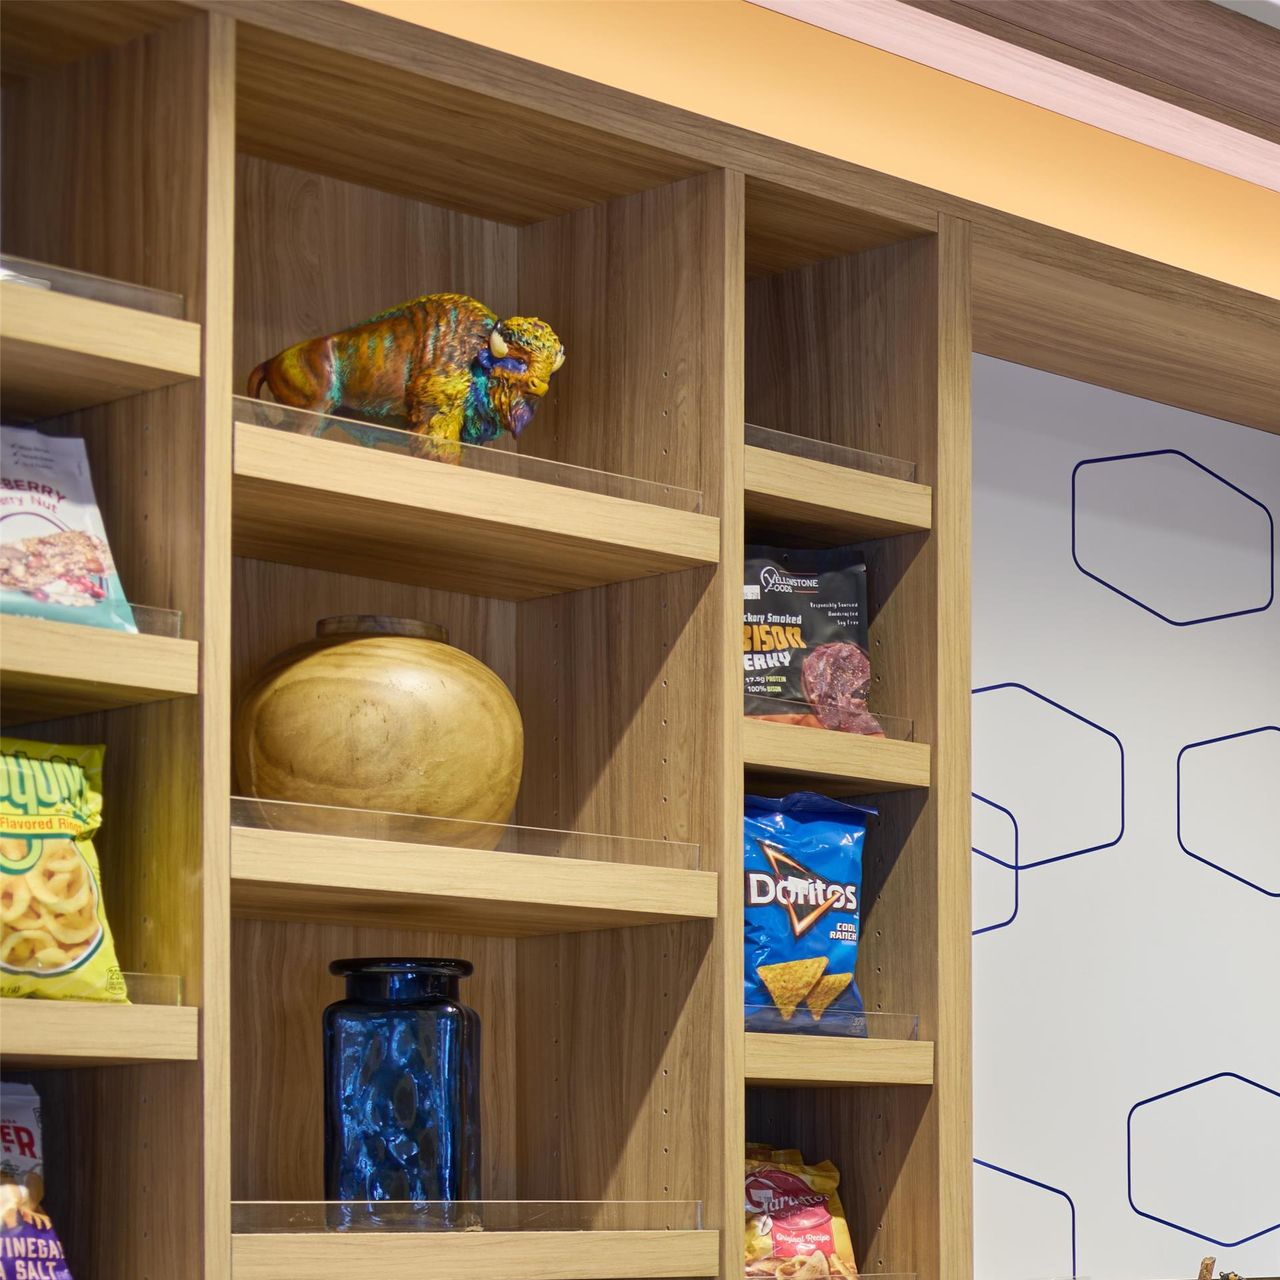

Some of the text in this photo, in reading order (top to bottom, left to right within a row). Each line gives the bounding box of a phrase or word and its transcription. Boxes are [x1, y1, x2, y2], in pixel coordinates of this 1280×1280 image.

[767, 613, 802, 625] Smoked
[743, 624, 807, 651] BISON
[749, 872, 857, 911] Doritos
[836, 923, 857, 932] COOL
[829, 931, 857, 941] RANCH
[806, 1232, 831, 1242] Recipe
[15, 1260, 57, 1280] SALT
